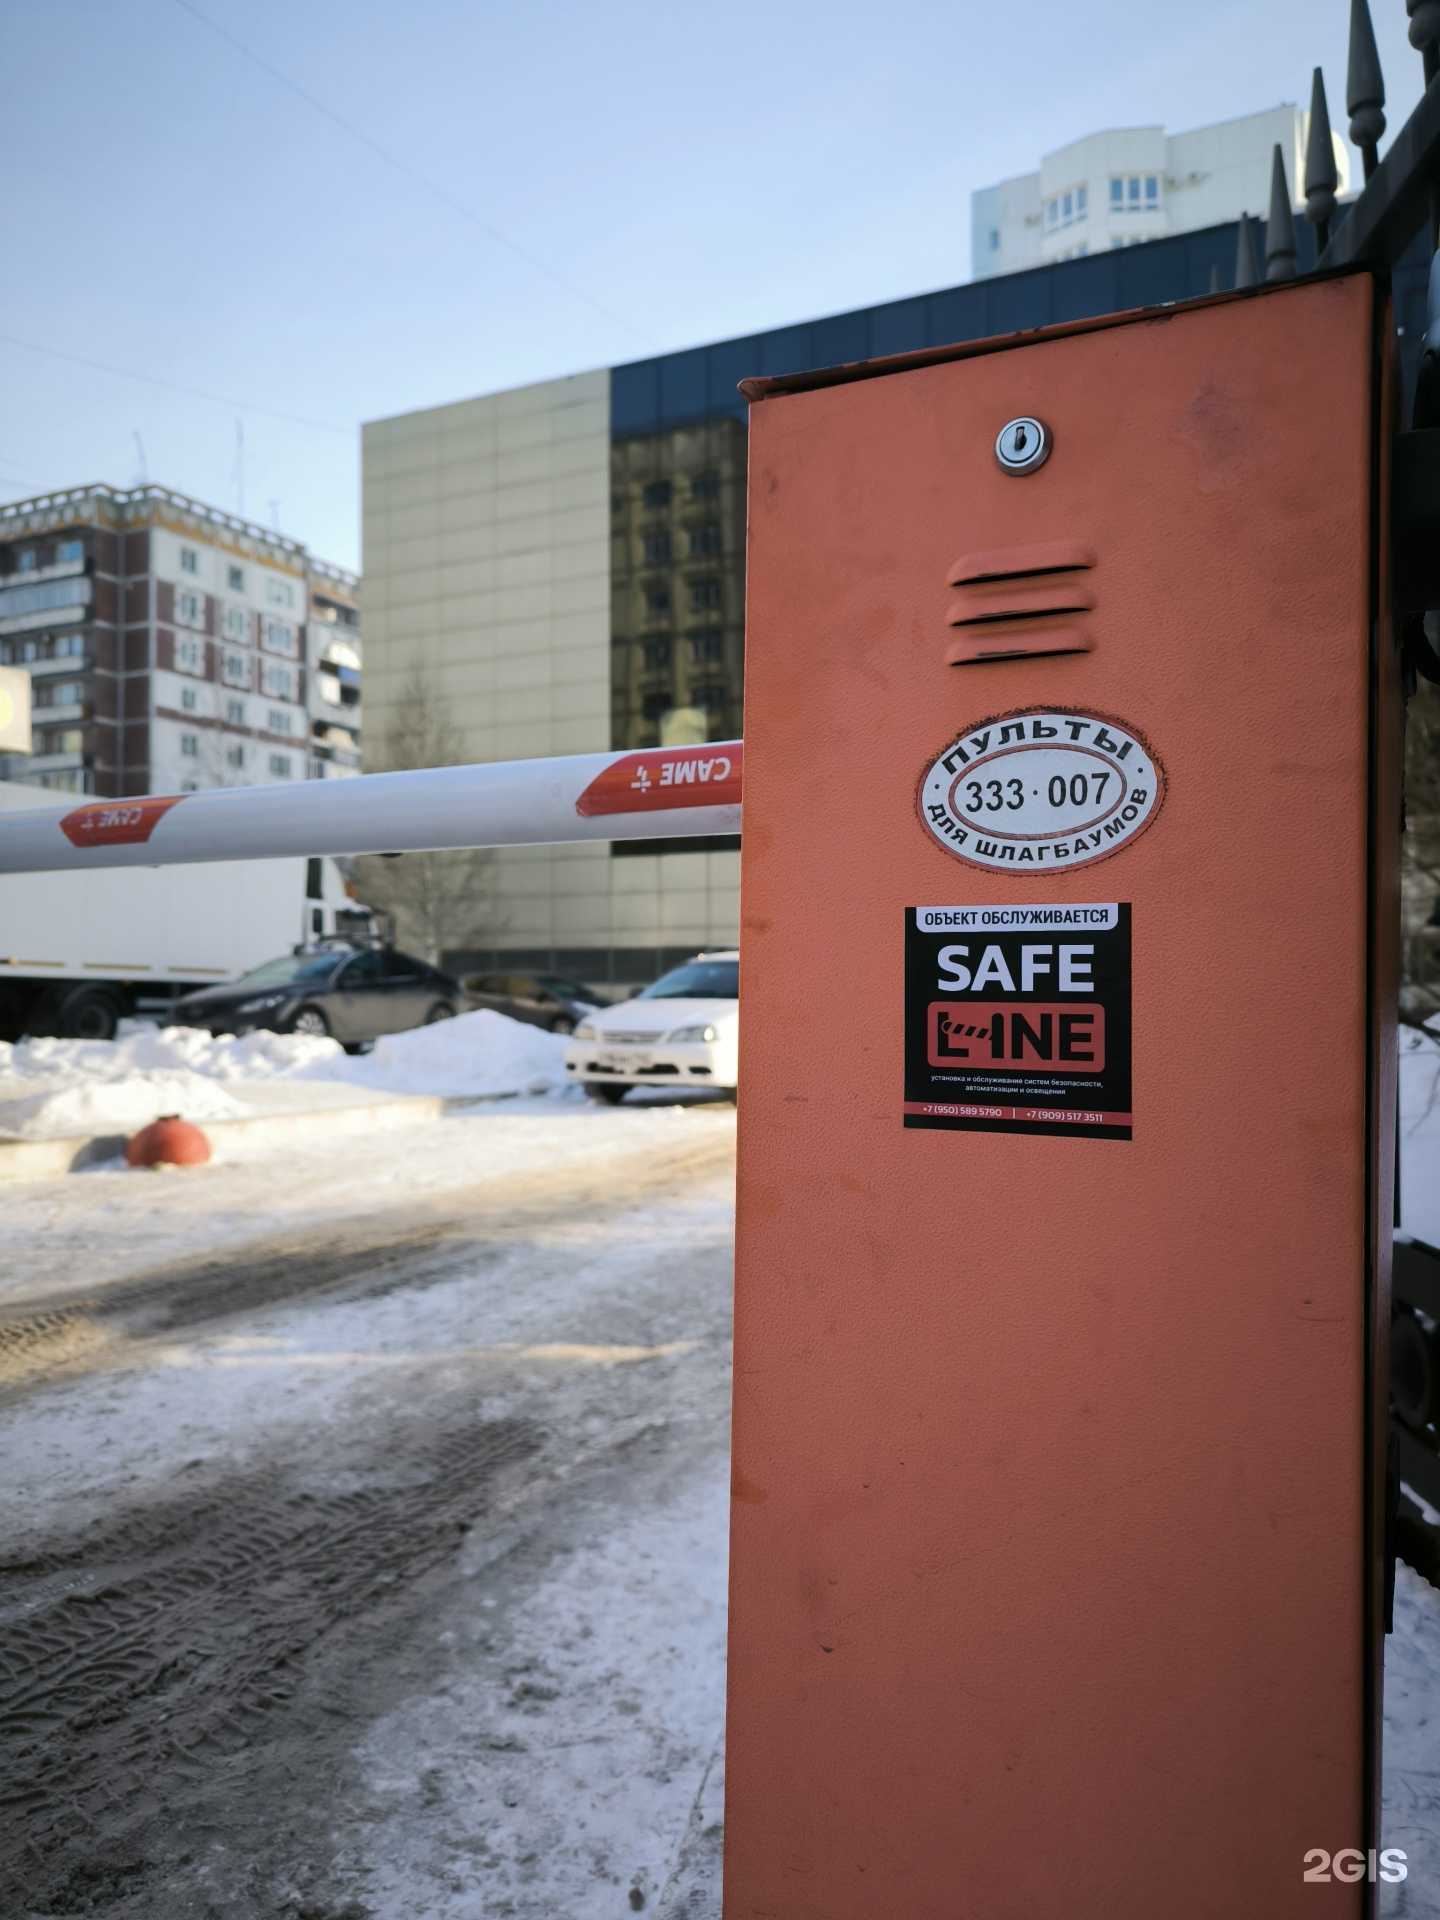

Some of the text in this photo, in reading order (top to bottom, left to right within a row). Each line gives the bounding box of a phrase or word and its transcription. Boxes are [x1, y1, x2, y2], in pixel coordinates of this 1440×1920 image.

[941, 720, 1134, 775] ПУЛЬТЫ
[659, 757, 732, 786] CAME
[927, 788, 1148, 861] ДЛЯ ШЛАГБАУМОВ
[924, 909, 1109, 926] ОБЪЕКТ ОБСЛУЖИВАЕТСЯ
[937, 944, 1095, 992] SAFE
[937, 1011, 1095, 1062] LINE
[934, 1105, 959, 1115] (950)
[978, 1107, 1002, 1117] 5790
[1038, 1111, 1065, 1121] (909)
[1067, 1112, 1082, 1121] 517
[1083, 1113, 1103, 1122] 3511
